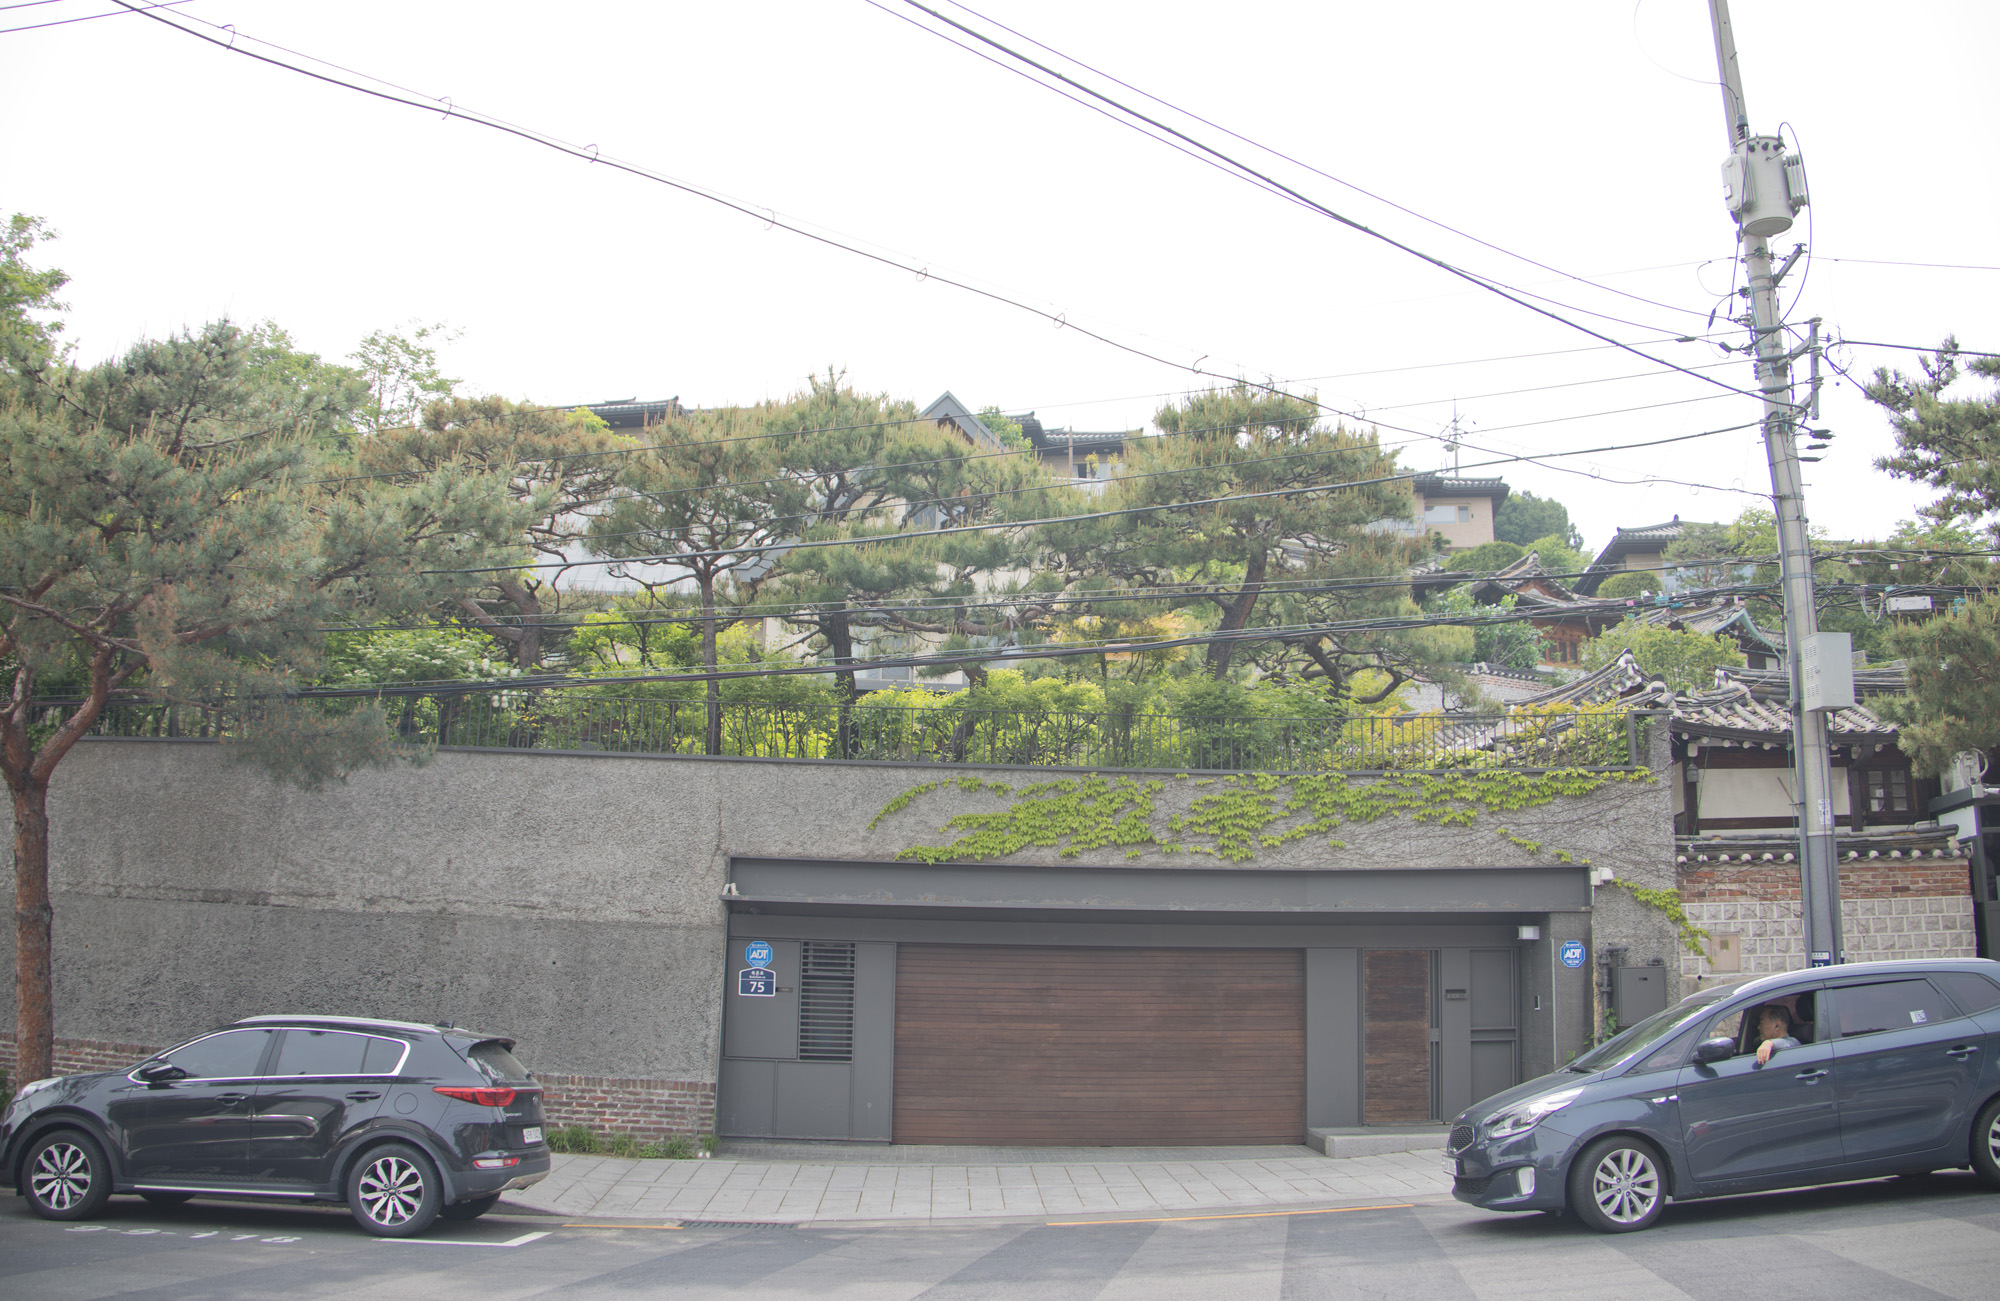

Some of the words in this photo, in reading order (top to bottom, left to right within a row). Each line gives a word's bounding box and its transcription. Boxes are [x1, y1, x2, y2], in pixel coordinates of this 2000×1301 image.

[750, 950, 768, 959] ADT
[1564, 948, 1582, 959] ADT
[749, 981, 765, 993] 75
